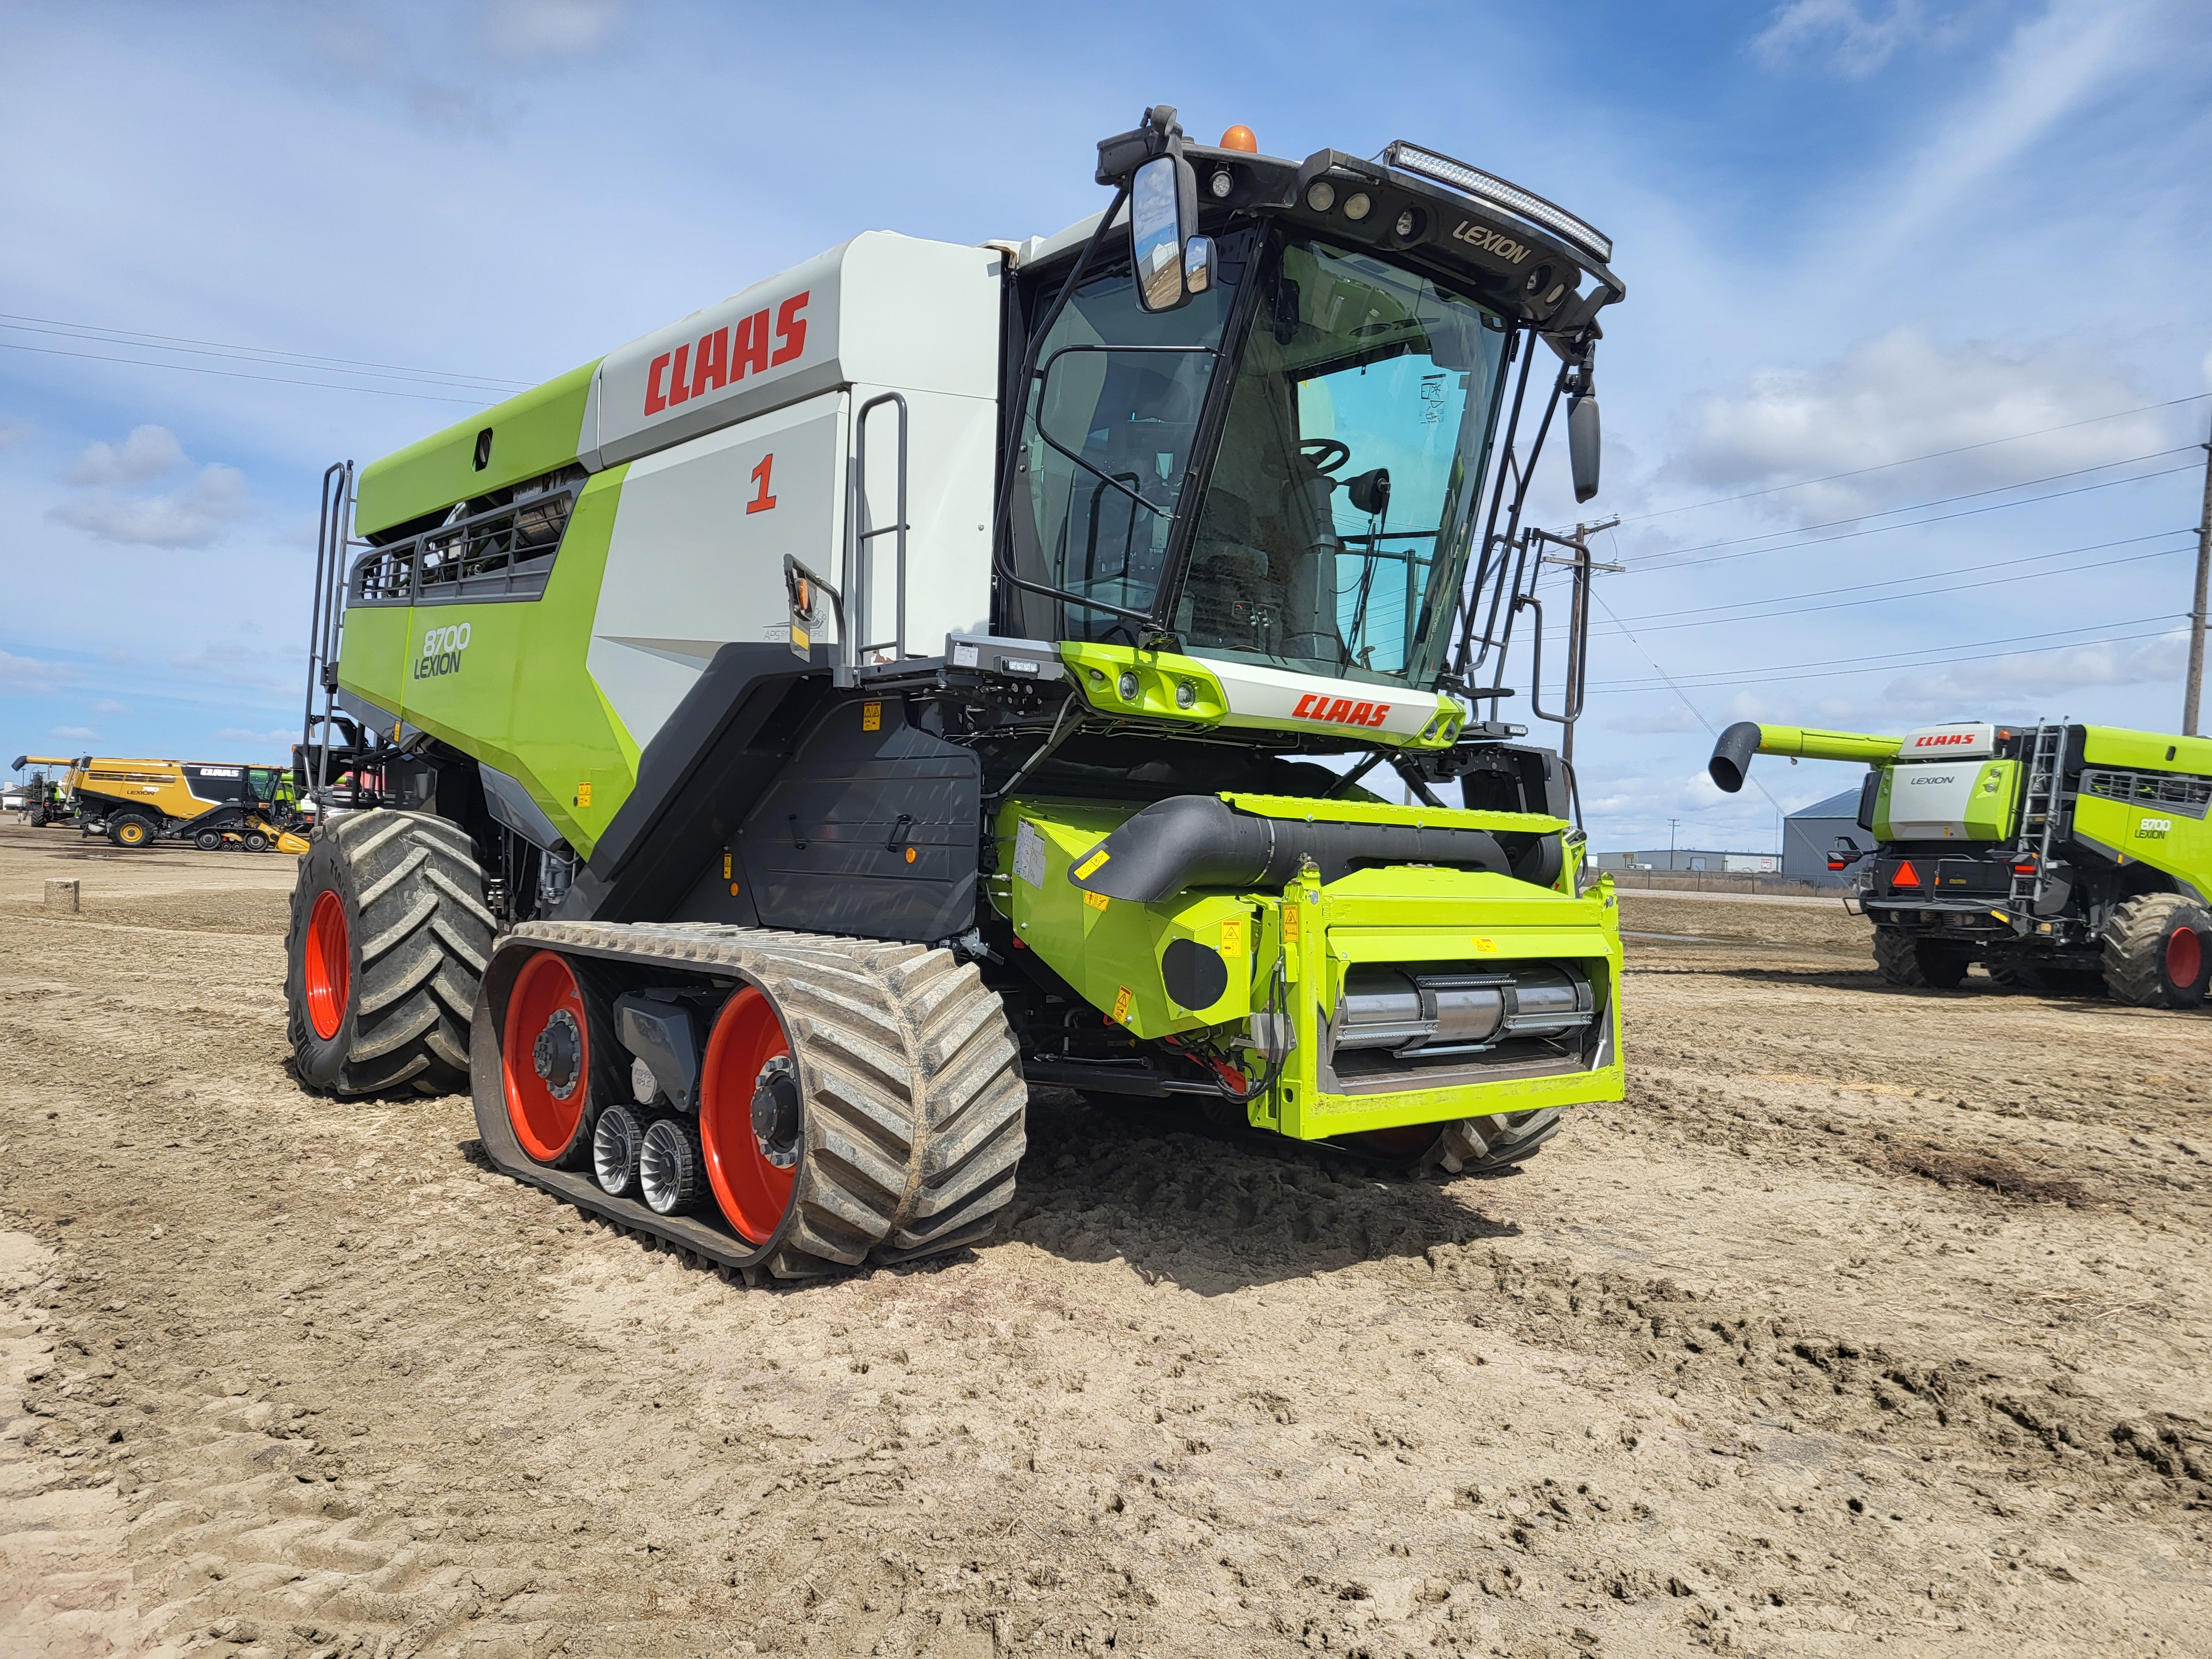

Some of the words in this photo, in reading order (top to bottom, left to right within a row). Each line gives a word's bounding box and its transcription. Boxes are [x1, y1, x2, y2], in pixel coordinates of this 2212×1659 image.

[1452, 220, 1532, 264] LEXION
[644, 289, 810, 417] CLAAS
[745, 452, 777, 515] 1
[423, 622, 471, 657] 8700
[414, 650, 462, 680] LEXION
[1291, 693, 1391, 727] CLAAS
[1914, 734, 1975, 747] CLAAS
[200, 768, 239, 777] CLAAS
[1910, 776, 1955, 785] LEXION
[2134, 829, 2166, 839] LEXION
[2140, 818, 2172, 831] 8700
